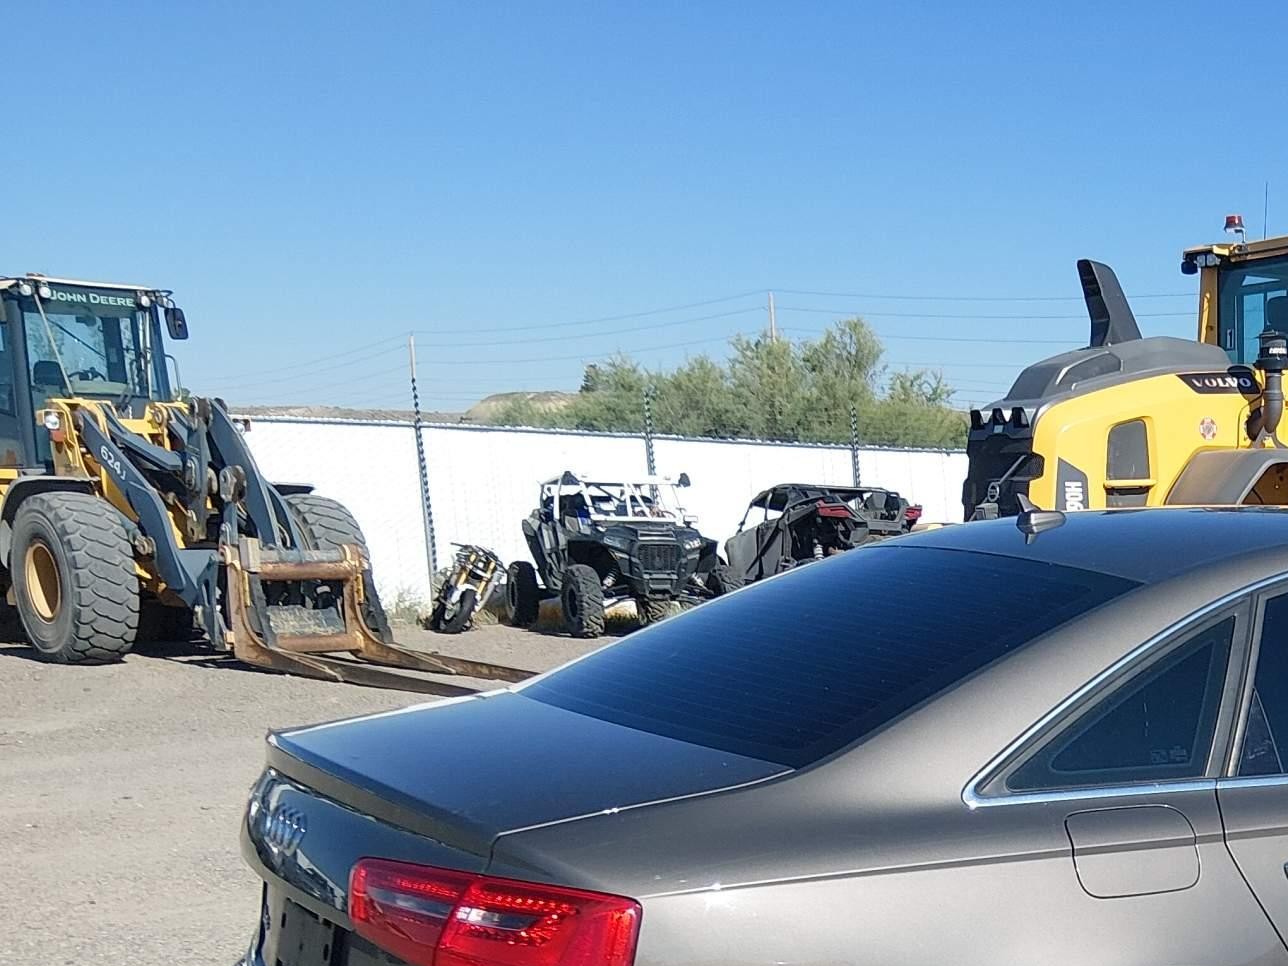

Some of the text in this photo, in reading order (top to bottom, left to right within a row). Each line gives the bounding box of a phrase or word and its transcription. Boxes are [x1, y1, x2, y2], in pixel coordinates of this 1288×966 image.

[50, 289, 135, 307] JOHN DEERE
[1191, 377, 1251, 388] VOLVO
[100, 445, 126, 481] 624J
